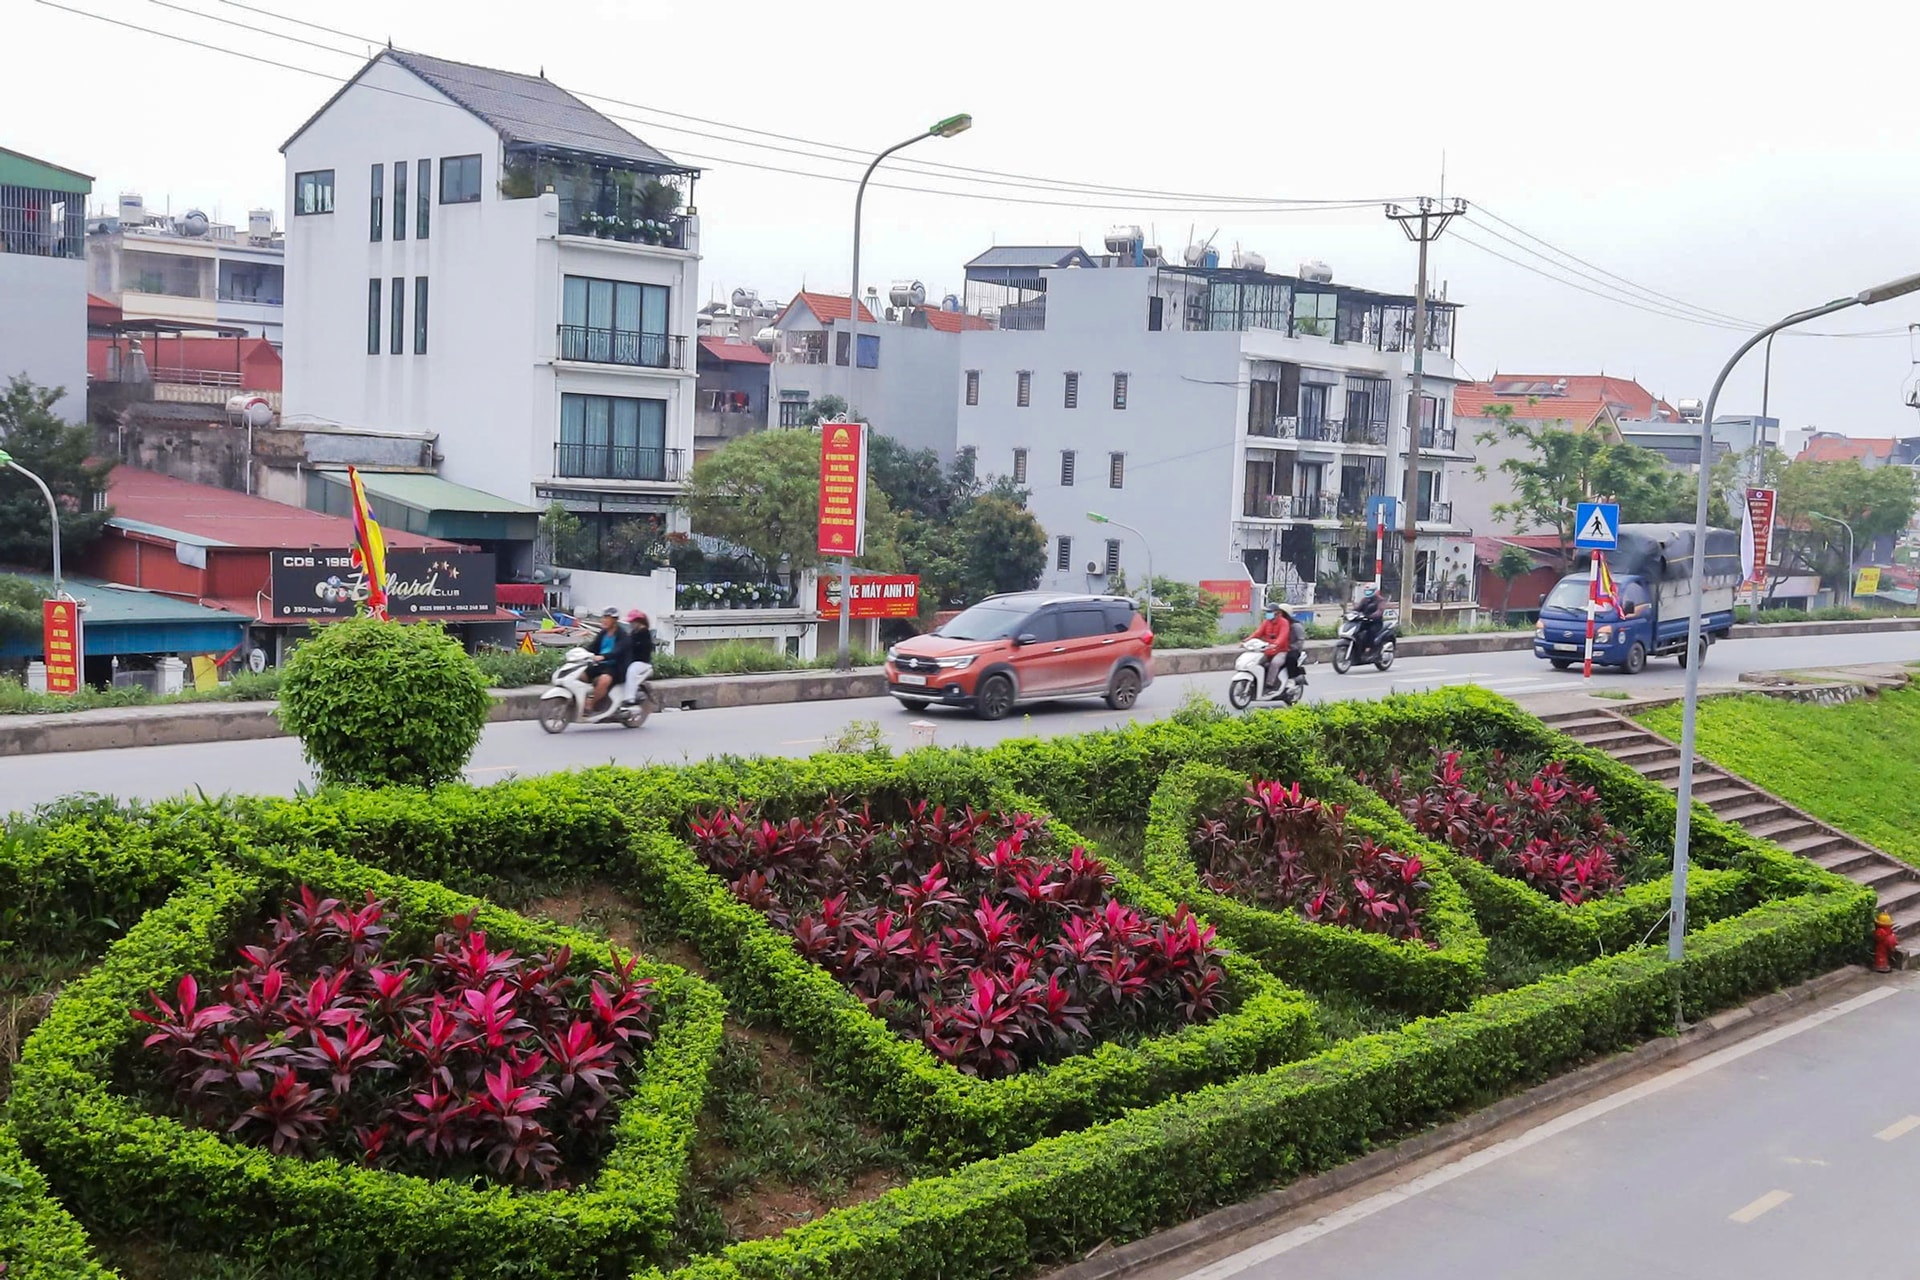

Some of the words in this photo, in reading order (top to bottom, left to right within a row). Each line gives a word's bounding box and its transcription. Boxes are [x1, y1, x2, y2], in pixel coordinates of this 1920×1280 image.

[325, 557, 353, 567] 198
[347, 572, 438, 601] Bliard
[432, 588, 460, 597] CLUB
[861, 581, 882, 598] MÁY
[883, 583, 902, 598] ANH
[904, 581, 915, 598] TÚ
